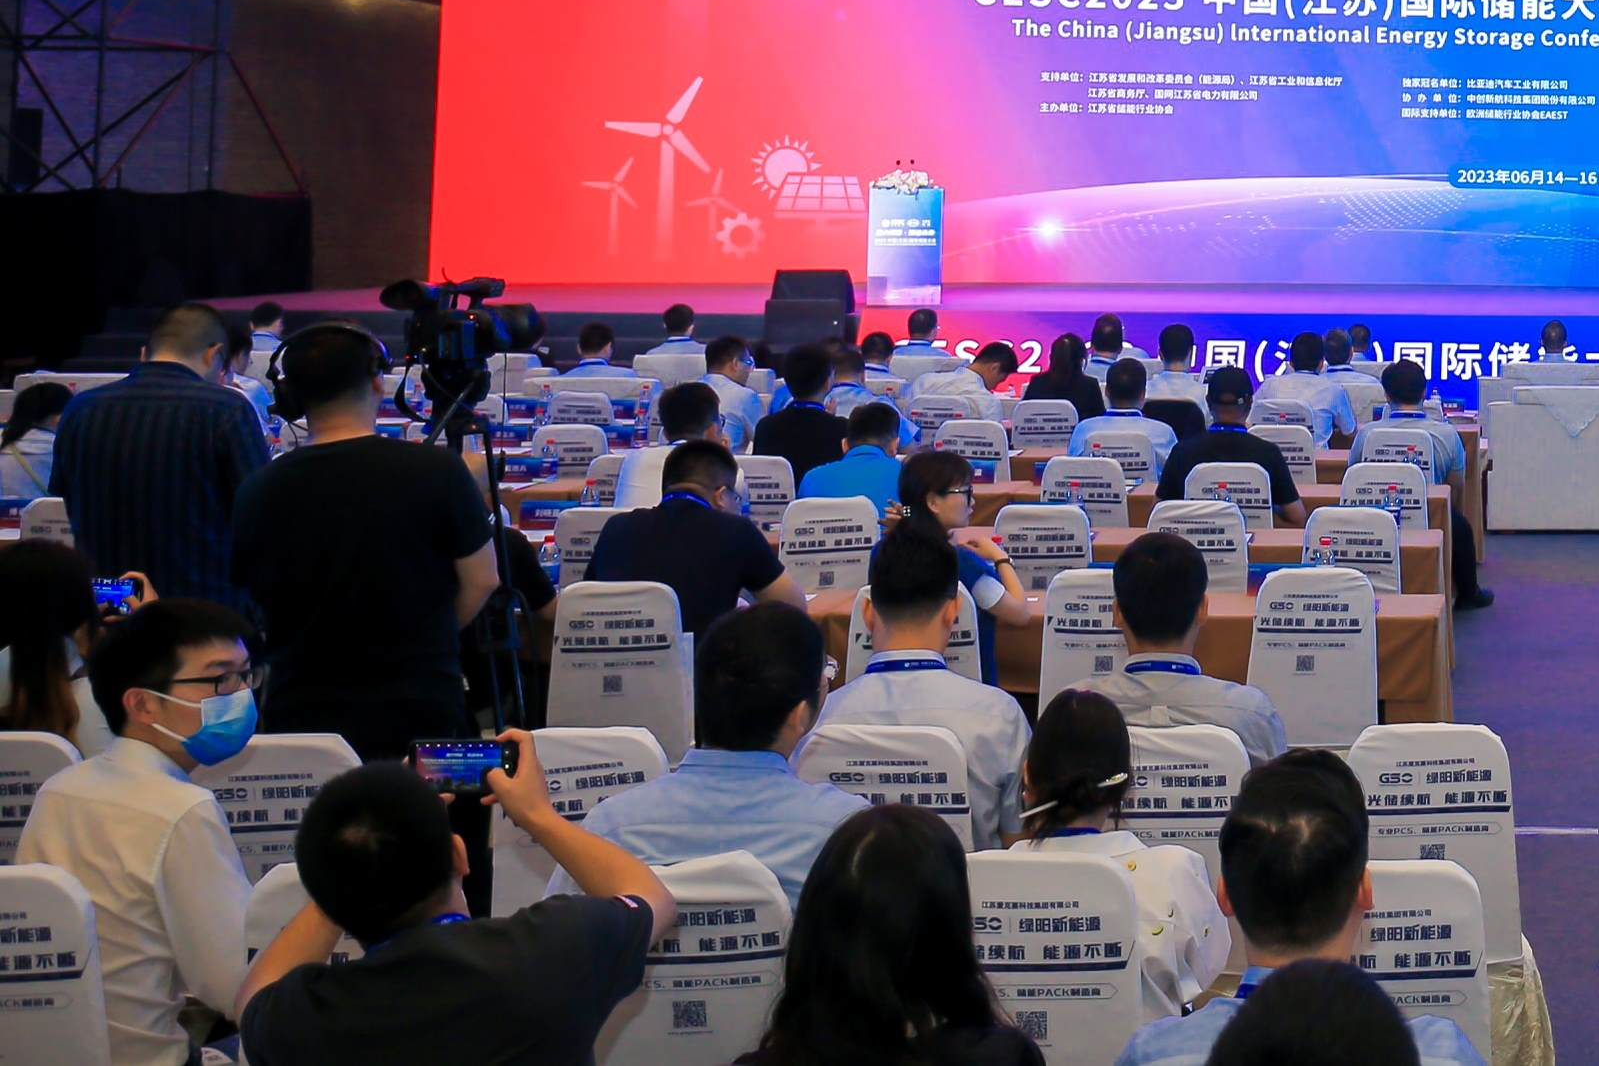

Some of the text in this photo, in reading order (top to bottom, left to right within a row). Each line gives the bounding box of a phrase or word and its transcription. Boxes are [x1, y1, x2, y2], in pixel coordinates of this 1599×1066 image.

[1011, 19, 1050, 38] The
[1058, 20, 1118, 39] China
[1126, 20, 1224, 45] (Jiangsu)
[1231, 19, 1370, 45] International
[1376, 27, 1448, 50] Energy
[1454, 27, 1535, 51] Storage
[576, 771, 645, 790] 绿阳新能源
[879, 771, 948, 784] 绿阳新能源
[1161, 774, 1227, 788] 绿阳新能源
[1426, 769, 1492, 784] 绿阳新能源
[900, 792, 966, 805] 能源不断
[1121, 797, 1167, 809] 储续航
[1444, 790, 1507, 804] 能源不断
[552, 799, 583, 812] 续航
[973, 916, 1100, 932] SO 绿阳新能源
[0, 926, 52, 943] 新能源
[1370, 924, 1452, 942] 绿阳新能源
[699, 931, 780, 952] 能源不断
[975, 942, 1122, 960] 储续航 能源不断
[1394, 950, 1471, 968] 能源不断
